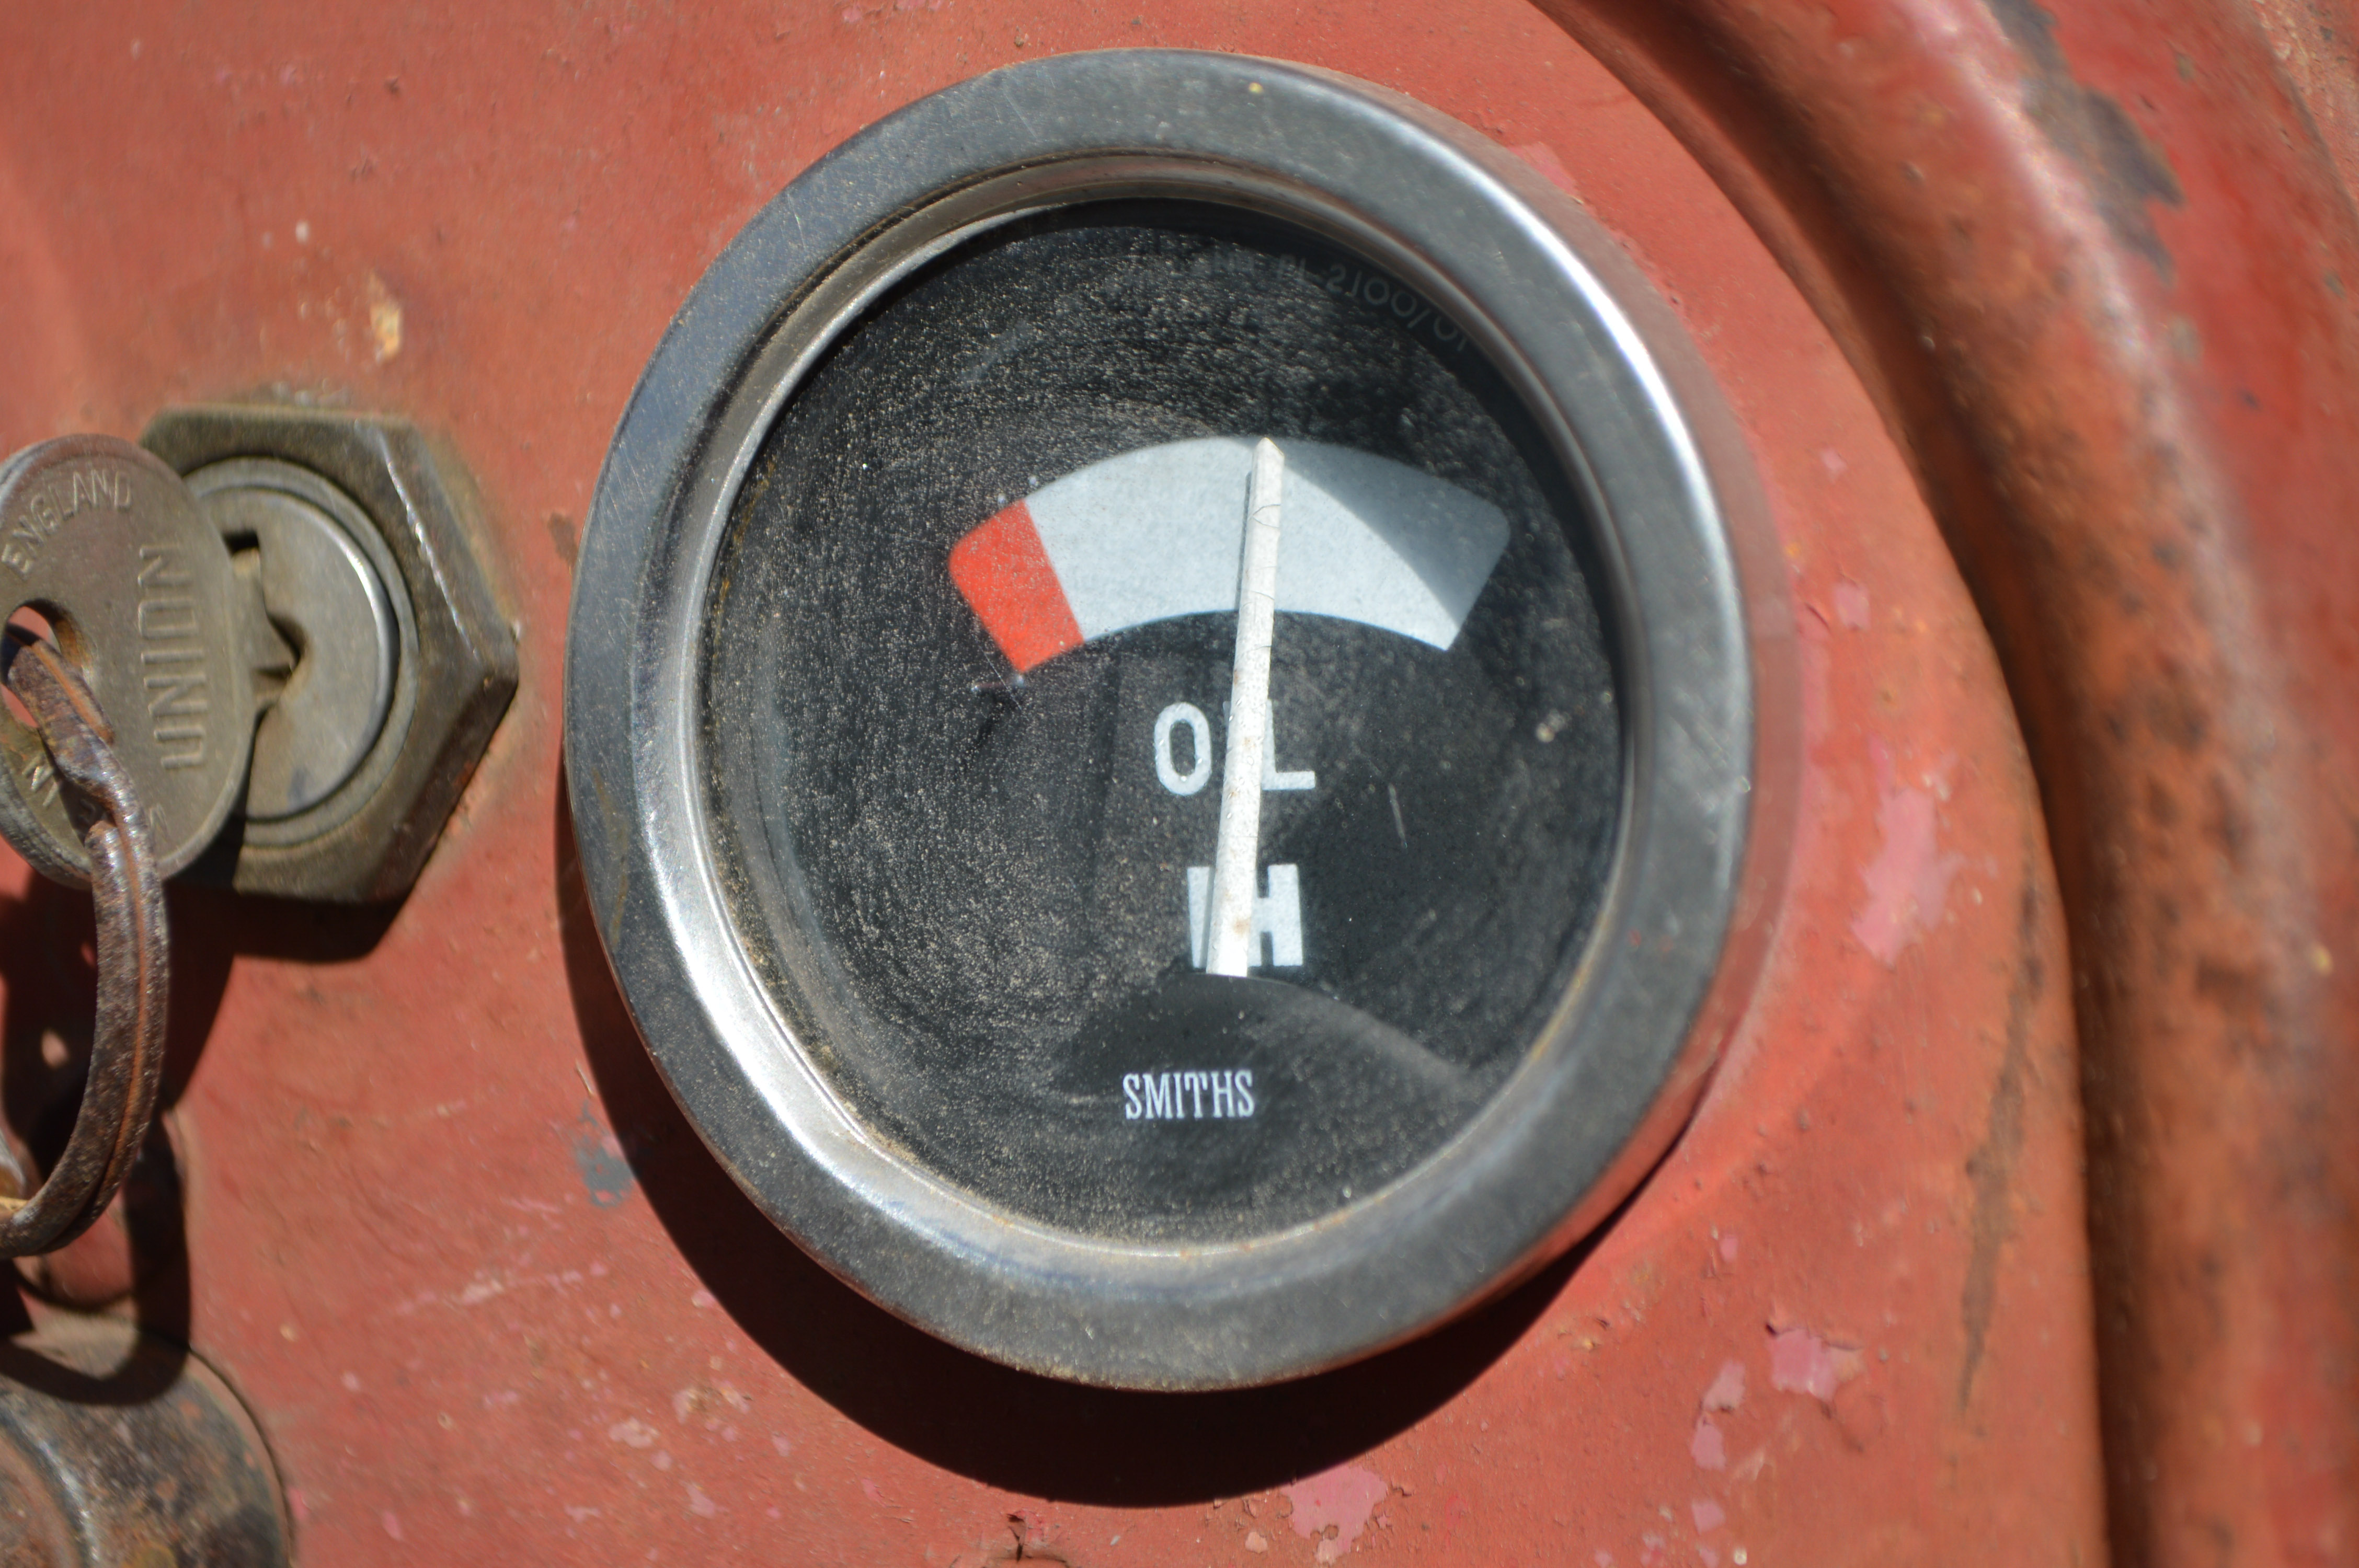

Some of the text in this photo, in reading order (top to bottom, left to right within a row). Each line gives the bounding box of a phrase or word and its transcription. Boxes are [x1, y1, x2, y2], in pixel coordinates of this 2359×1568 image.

[1, 469, 131, 581] ENGLAND
[138, 544, 208, 770] UNION
[1154, 700, 1316, 796] OL
[1123, 1069, 1255, 1121] SMITHS
